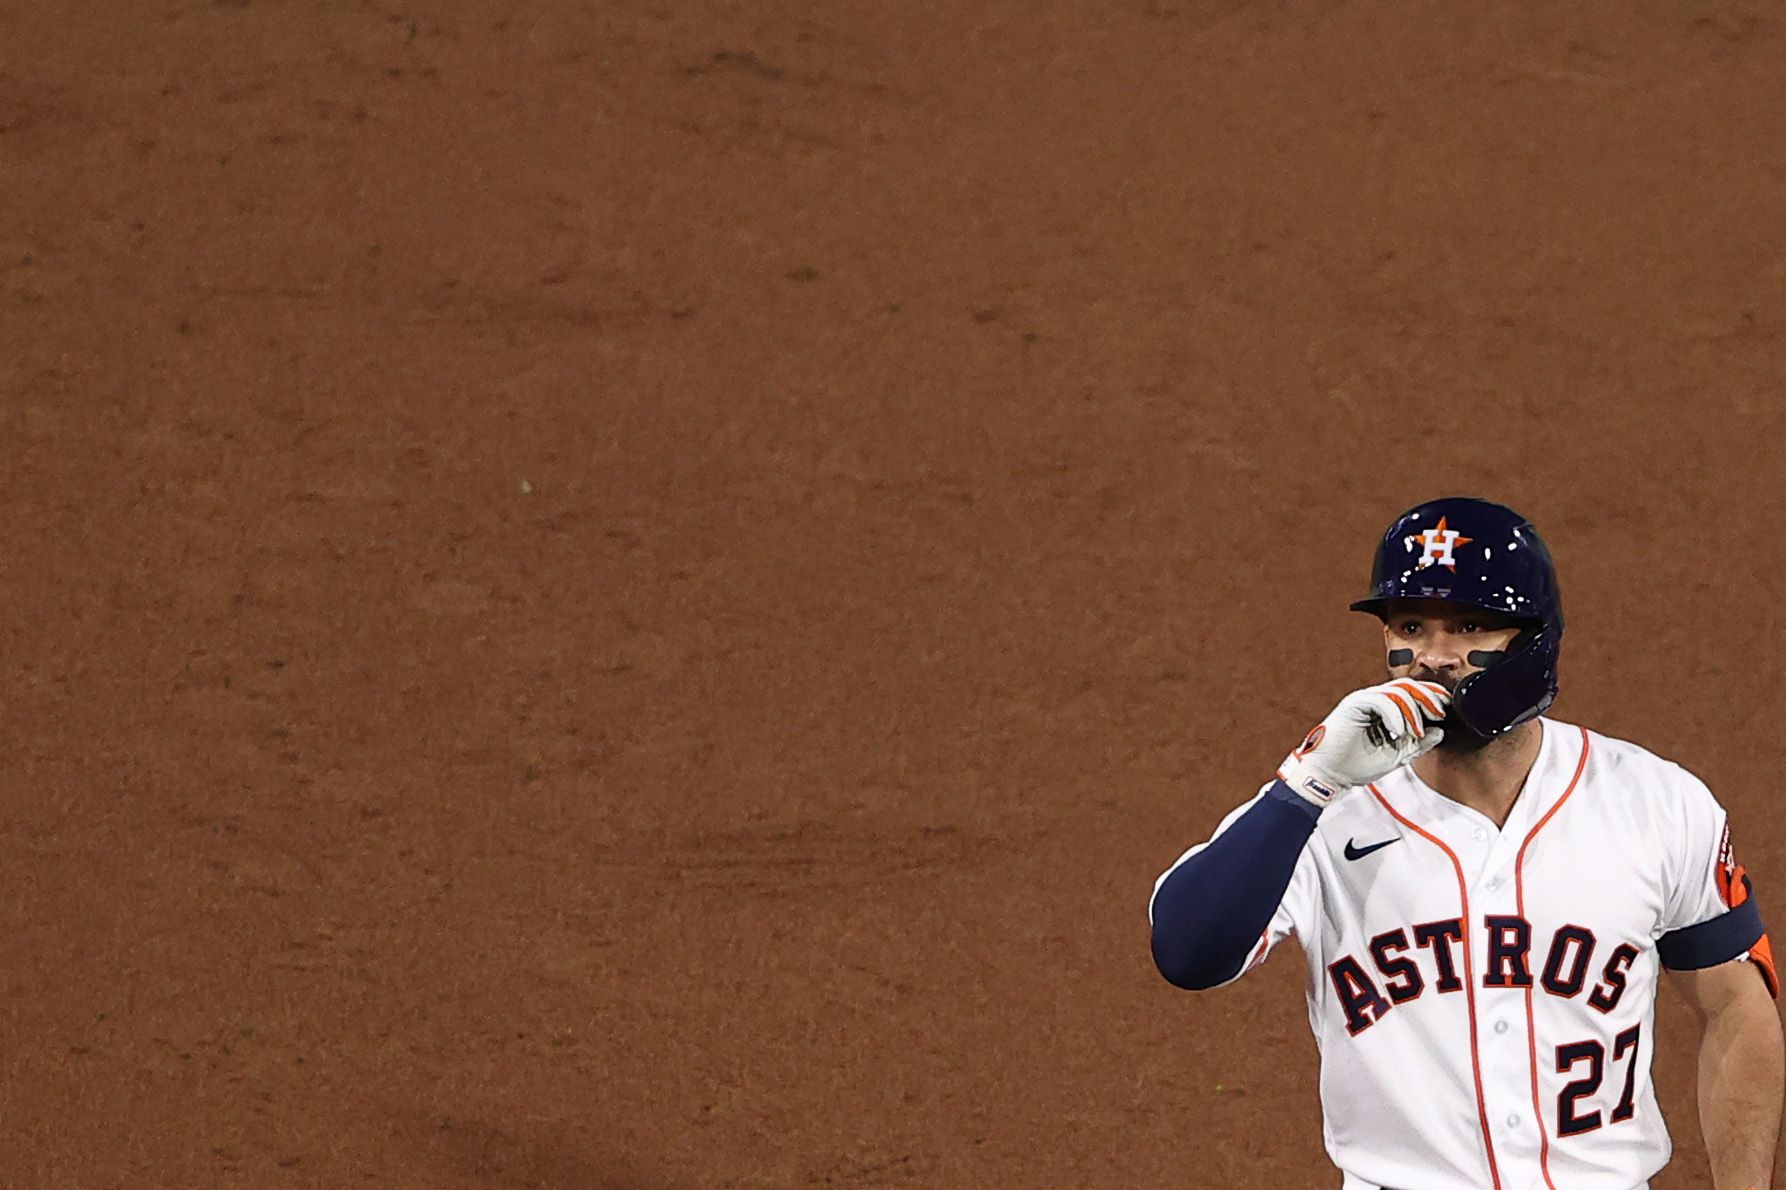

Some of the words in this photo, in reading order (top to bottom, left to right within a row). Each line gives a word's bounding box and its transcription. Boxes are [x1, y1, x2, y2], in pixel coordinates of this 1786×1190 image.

[1418, 529, 1460, 566] H
[1327, 914, 1641, 1037] ASTROS
[1555, 1023, 1641, 1138] 27
